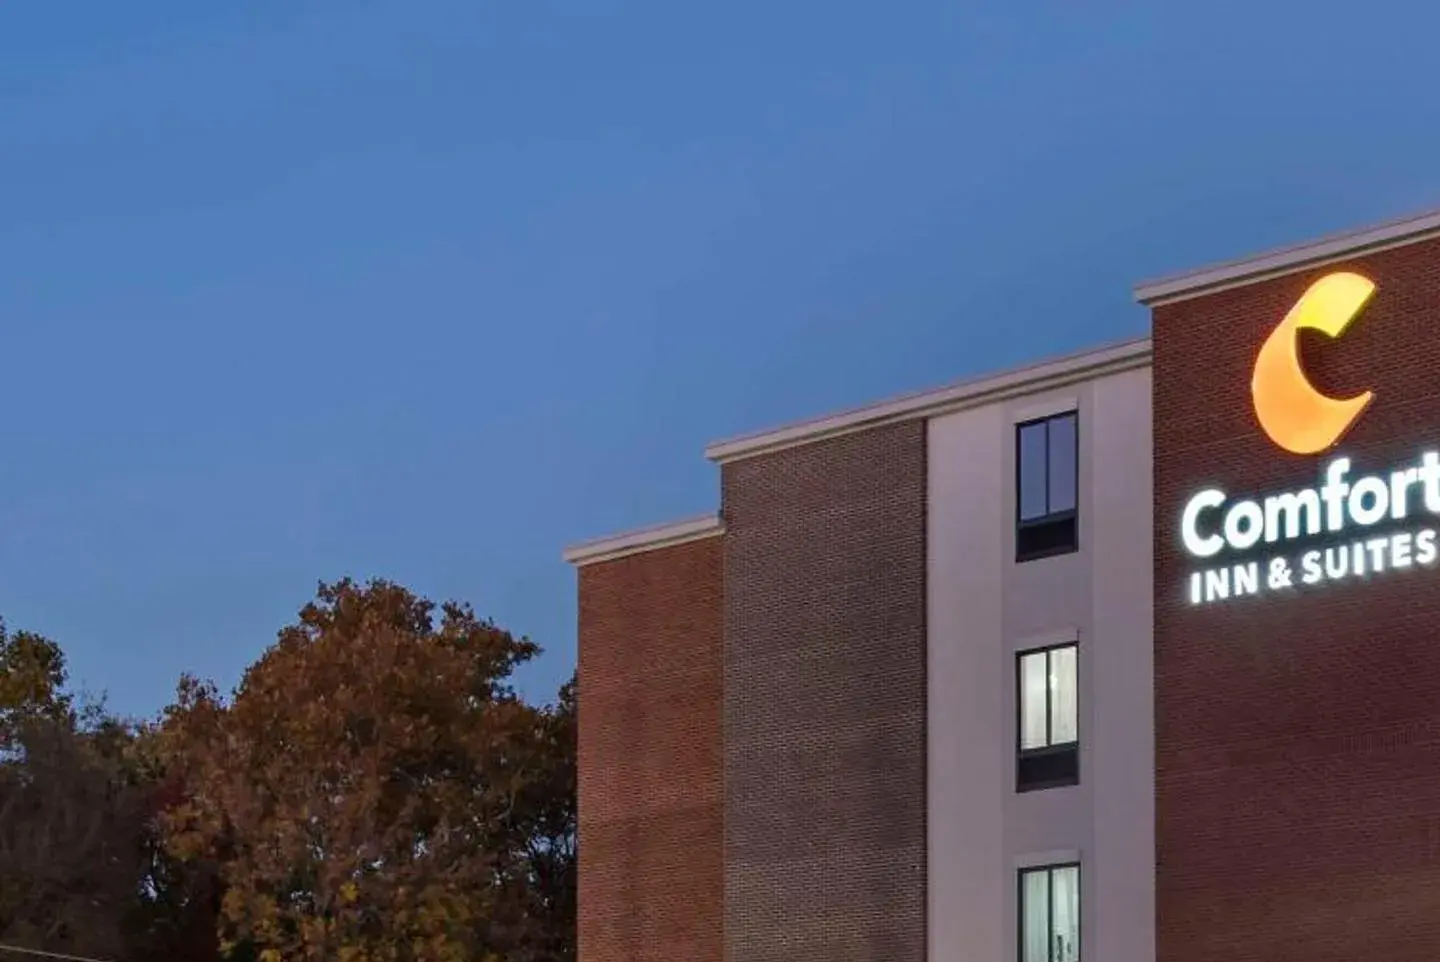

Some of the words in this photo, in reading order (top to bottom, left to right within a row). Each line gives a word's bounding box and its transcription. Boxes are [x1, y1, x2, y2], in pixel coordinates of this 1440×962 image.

[1190, 562, 1258, 603] INN
[1268, 557, 1293, 590] &
[1302, 529, 1437, 584] SUITES
